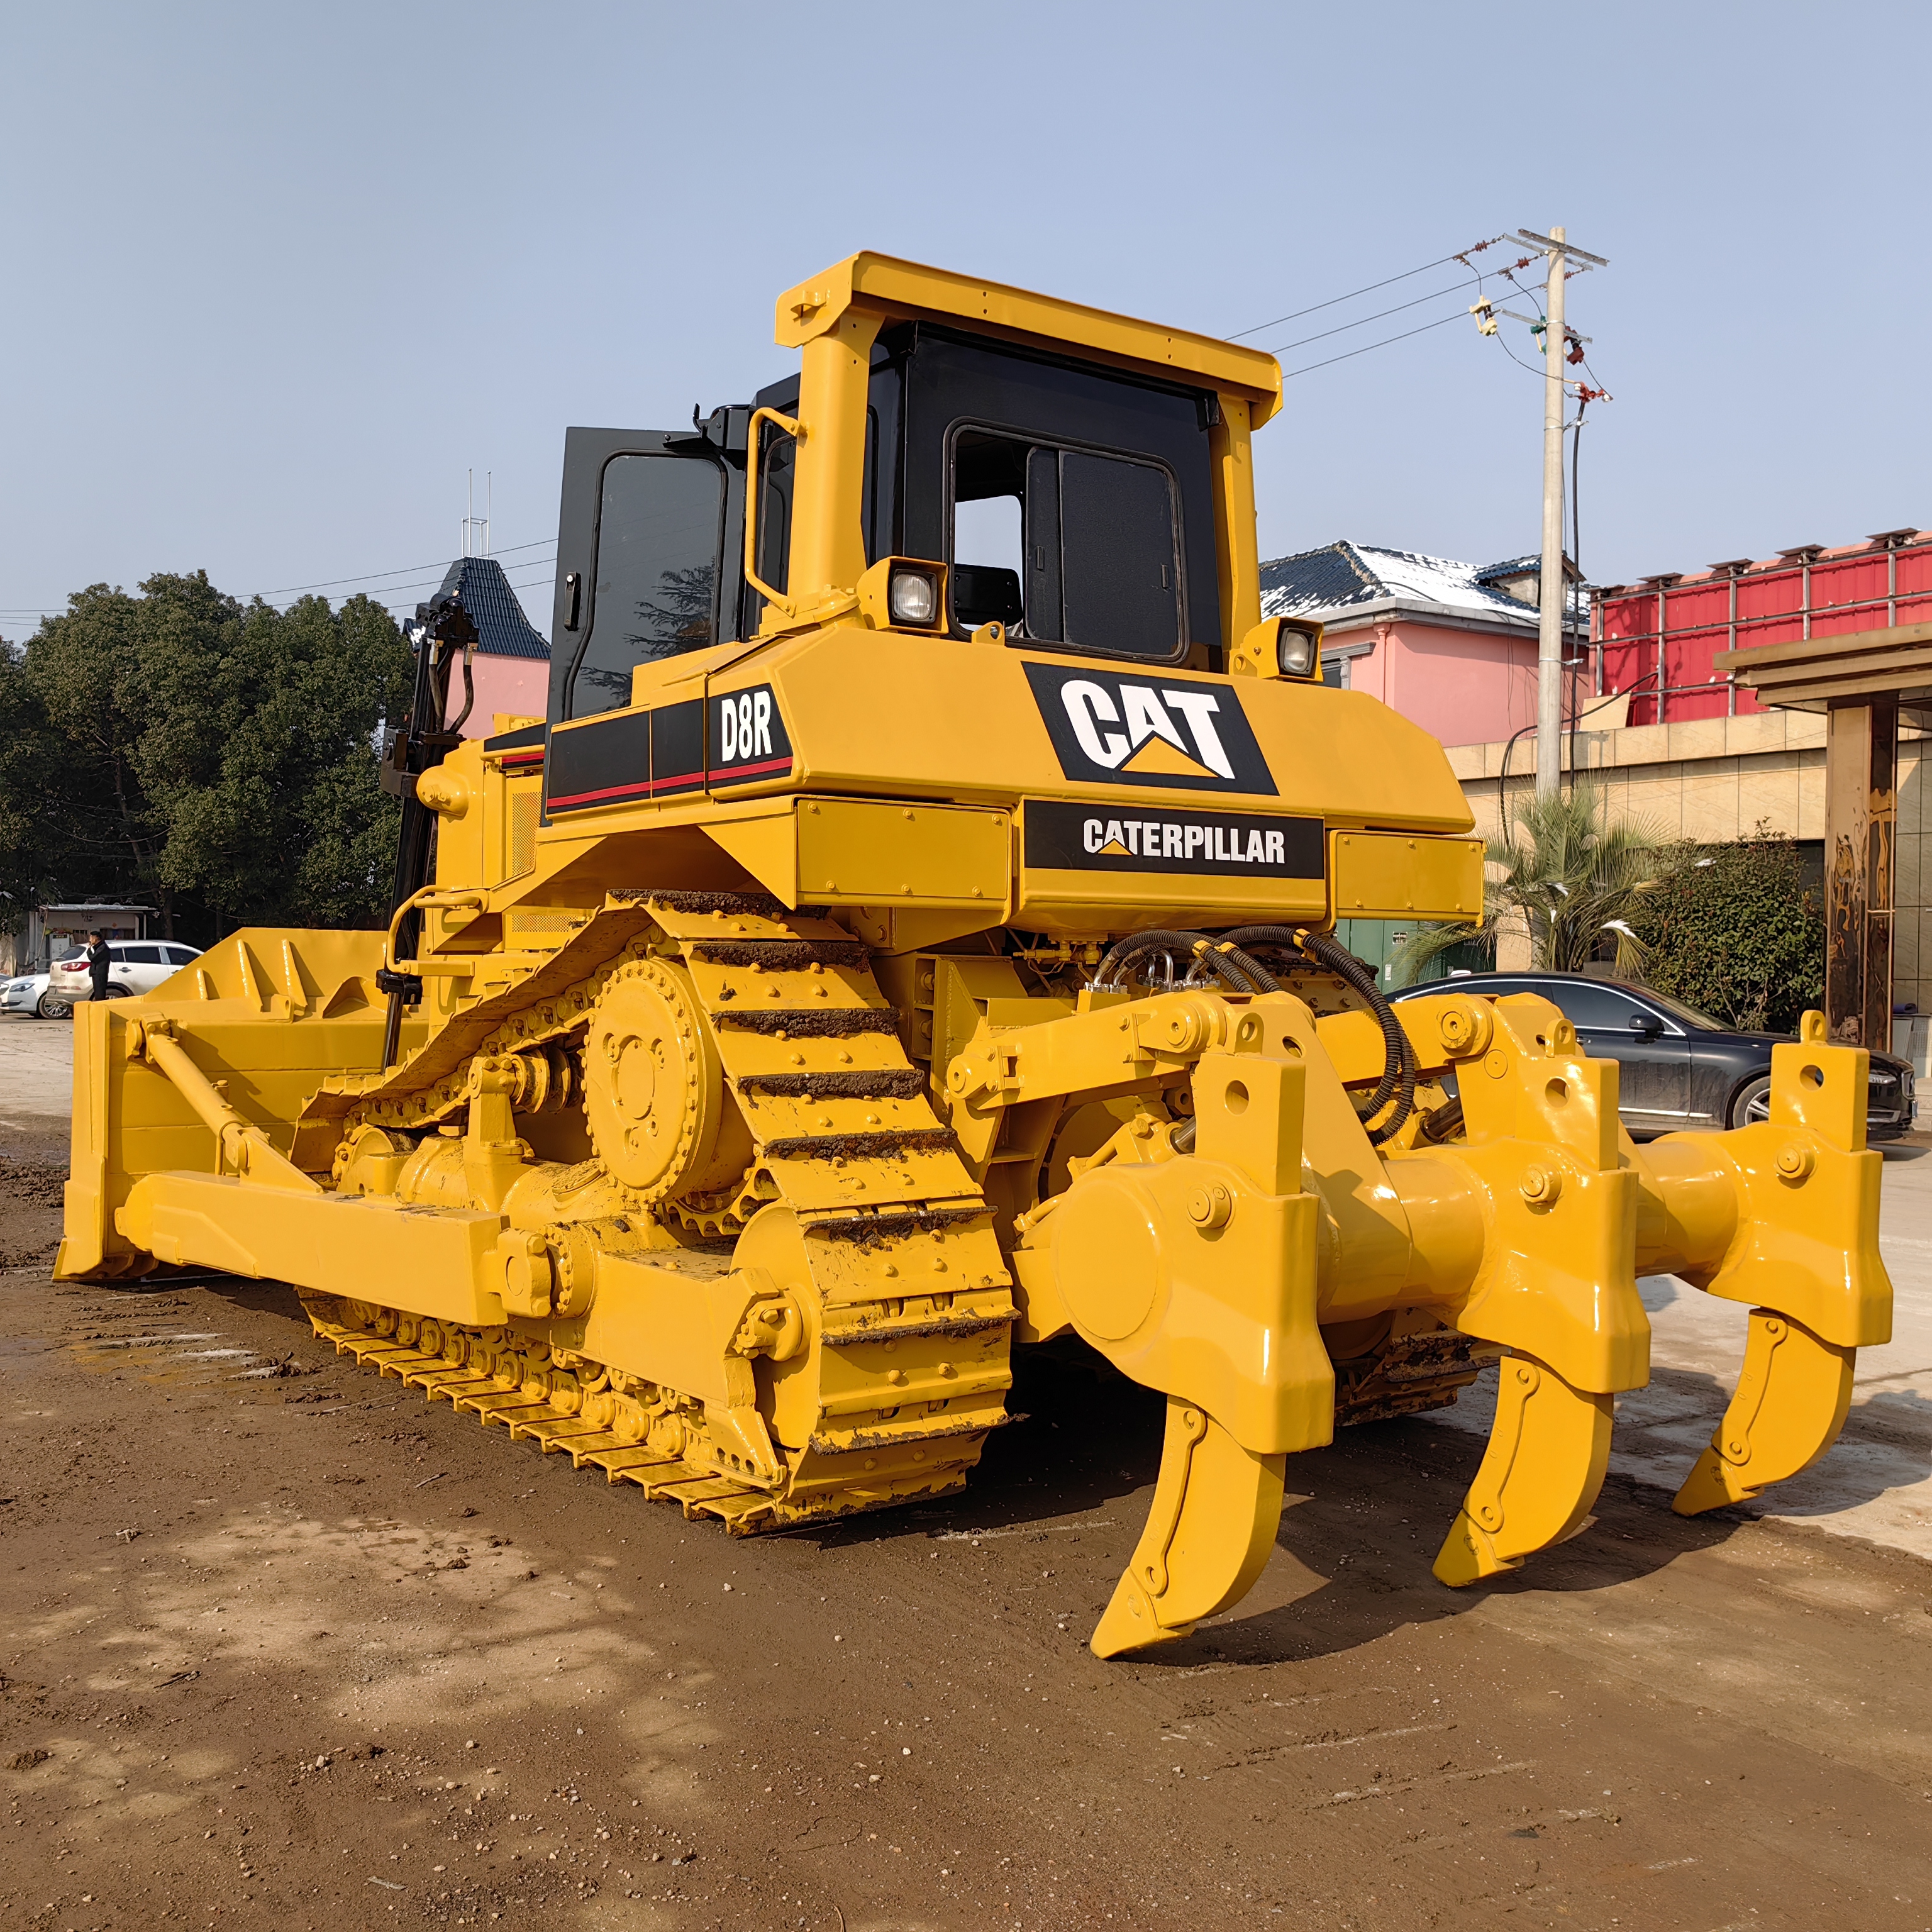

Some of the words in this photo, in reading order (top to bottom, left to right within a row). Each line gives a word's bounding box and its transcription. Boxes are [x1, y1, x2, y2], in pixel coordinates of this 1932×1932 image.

[722, 691, 772, 762] D8R
[1061, 680, 1235, 779] CAT
[1084, 819, 1284, 863] CATERPILLAR
